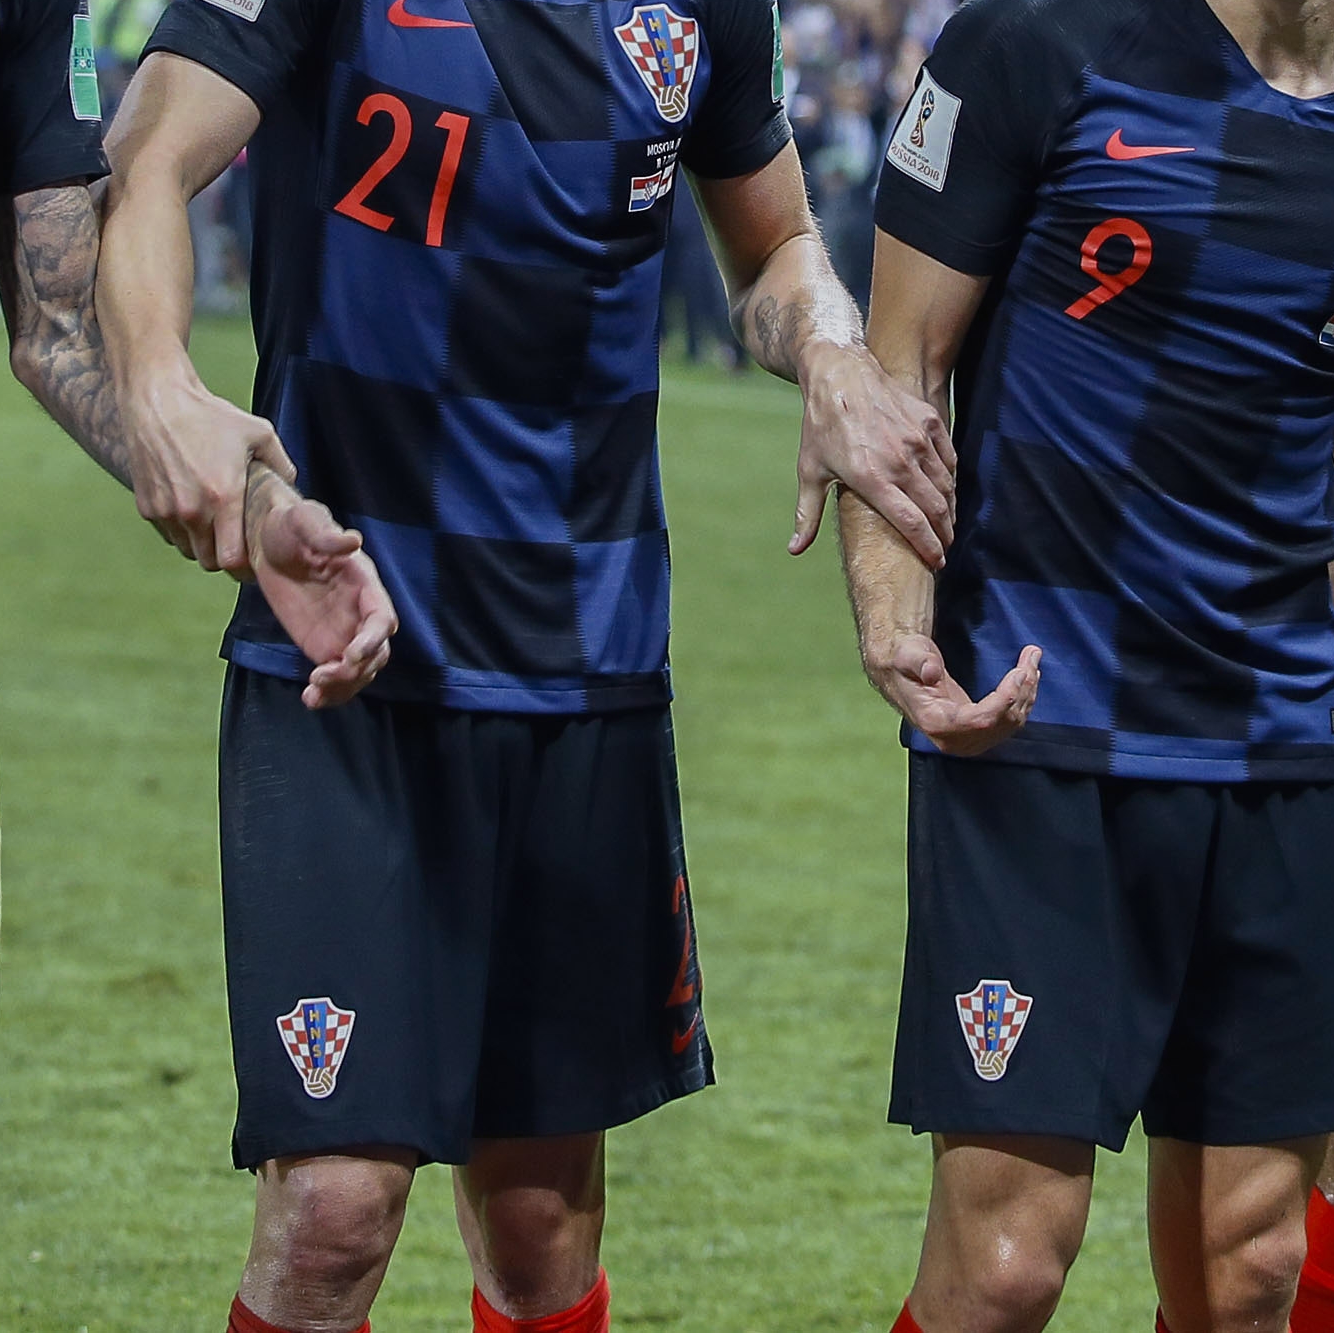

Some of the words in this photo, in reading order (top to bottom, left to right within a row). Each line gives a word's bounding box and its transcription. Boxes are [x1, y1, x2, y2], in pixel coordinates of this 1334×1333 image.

[334, 94, 470, 247] 21
[891, 142, 917, 168] RUSSIA
[917, 162, 940, 181] 2018
[1064, 217, 1152, 320] 9
[309, 1009, 322, 1058] HNS
[987, 991, 999, 1040] HNS
